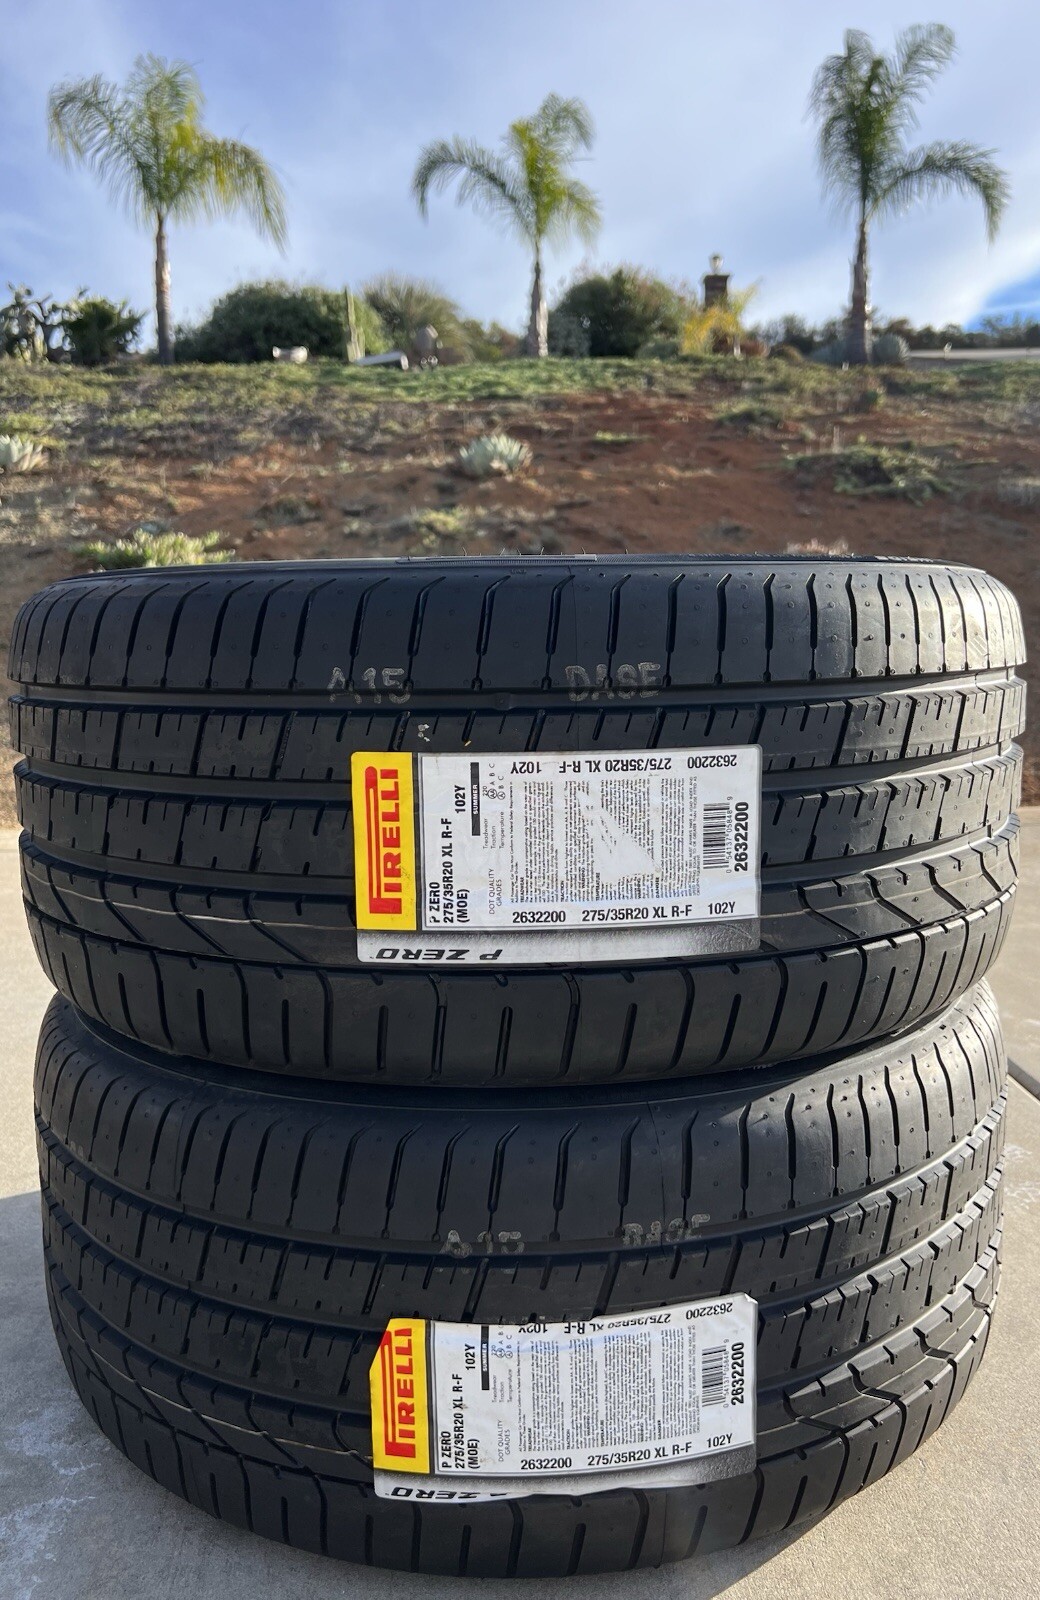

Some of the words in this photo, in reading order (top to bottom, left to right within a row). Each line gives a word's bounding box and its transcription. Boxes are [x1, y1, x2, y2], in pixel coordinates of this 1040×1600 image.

[510, 761, 542, 773] 102Y
[559, 761, 581, 773] R-F
[585, 760, 601, 772] XL
[605, 757, 672, 771] 275/35R20
[687, 754, 737, 769] 2632200
[455, 784, 465, 813] 102Y
[365, 766, 402, 914] PIRELLI
[441, 818, 452, 838] R-F
[734, 802, 748, 872] 2632200
[442, 843, 452, 857] XL
[429, 882, 439, 912] ZERO
[443, 861, 453, 923] 275/35R20
[457, 889, 469, 923] (MOE)
[512, 909, 566, 923] 2632200
[582, 907, 649, 922] 275/35R20
[653, 905, 668, 918] XL
[672, 904, 693, 917] R-F
[708, 901, 736, 916] 102Y
[479, 949, 503, 960] P
[686, 1302, 733, 1320] 2632200
[589, 1323, 603, 1331] XL
[465, 1344, 475, 1370] 102Y
[452, 1373, 463, 1392] R-F
[731, 1342, 744, 1406] 2632200
[380, 1328, 416, 1458] PIRELLI
[453, 1396, 463, 1409] XL
[441, 1431, 451, 1458] ZERO
[454, 1413, 465, 1469] 275/35R20
[520, 1457, 573, 1470] 2632200
[587, 1448, 651, 1466] 275/35R20
[654, 1445, 669, 1458] XL
[672, 1442, 693, 1456] R-F
[706, 1434, 734, 1448] 102Y
[468, 1439, 479, 1469] (MOE)
